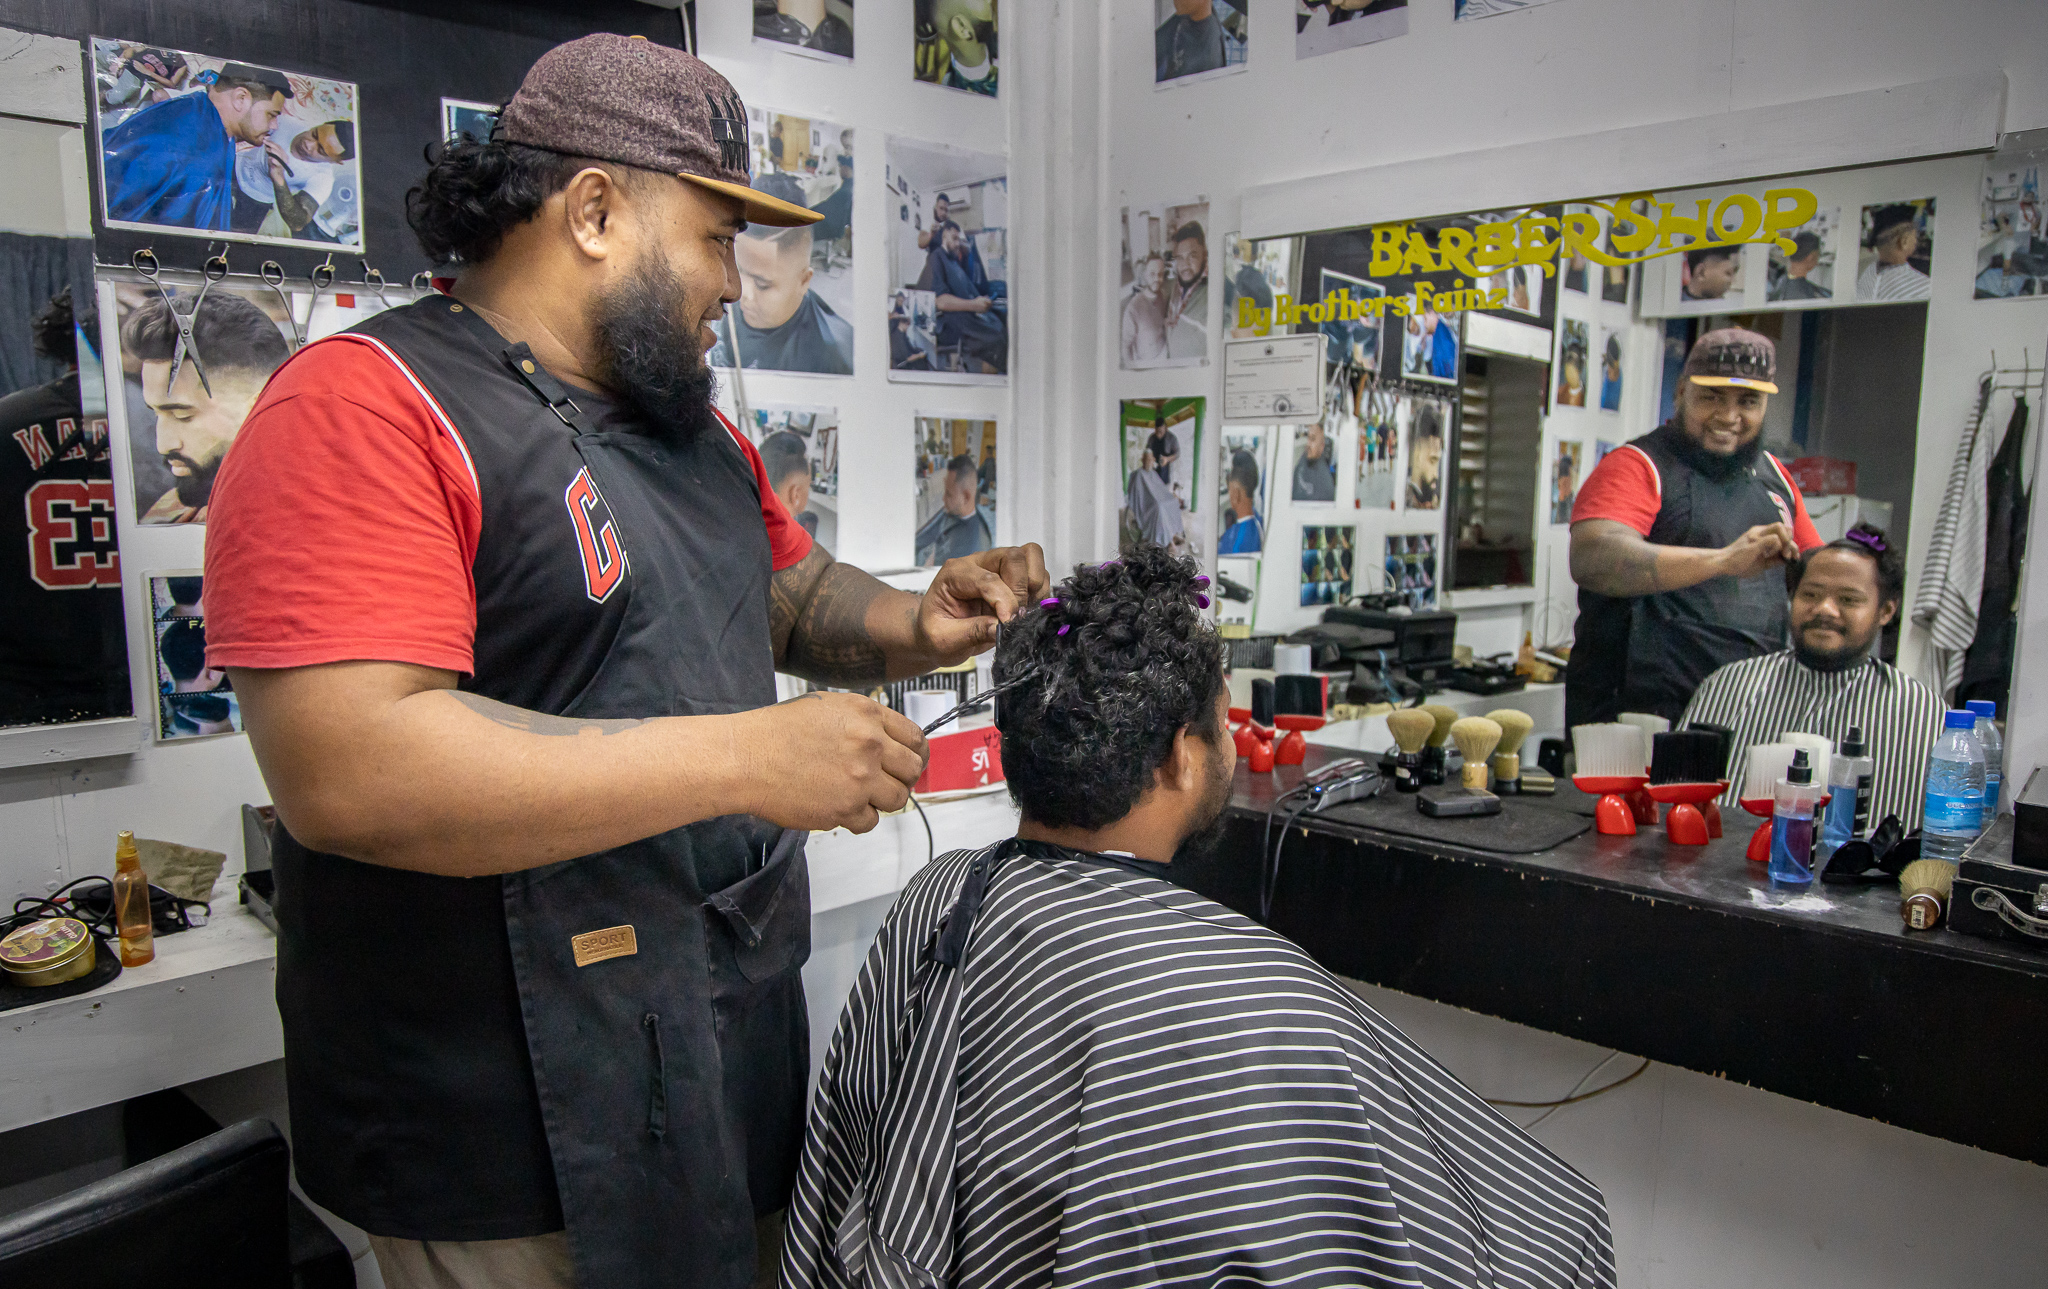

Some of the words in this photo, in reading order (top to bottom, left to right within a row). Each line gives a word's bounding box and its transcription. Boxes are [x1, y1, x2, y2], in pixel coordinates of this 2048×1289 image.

[1238, 297, 1272, 337] By
[1275, 287, 1411, 326] Brothers
[581, 933, 626, 951] SPORT
